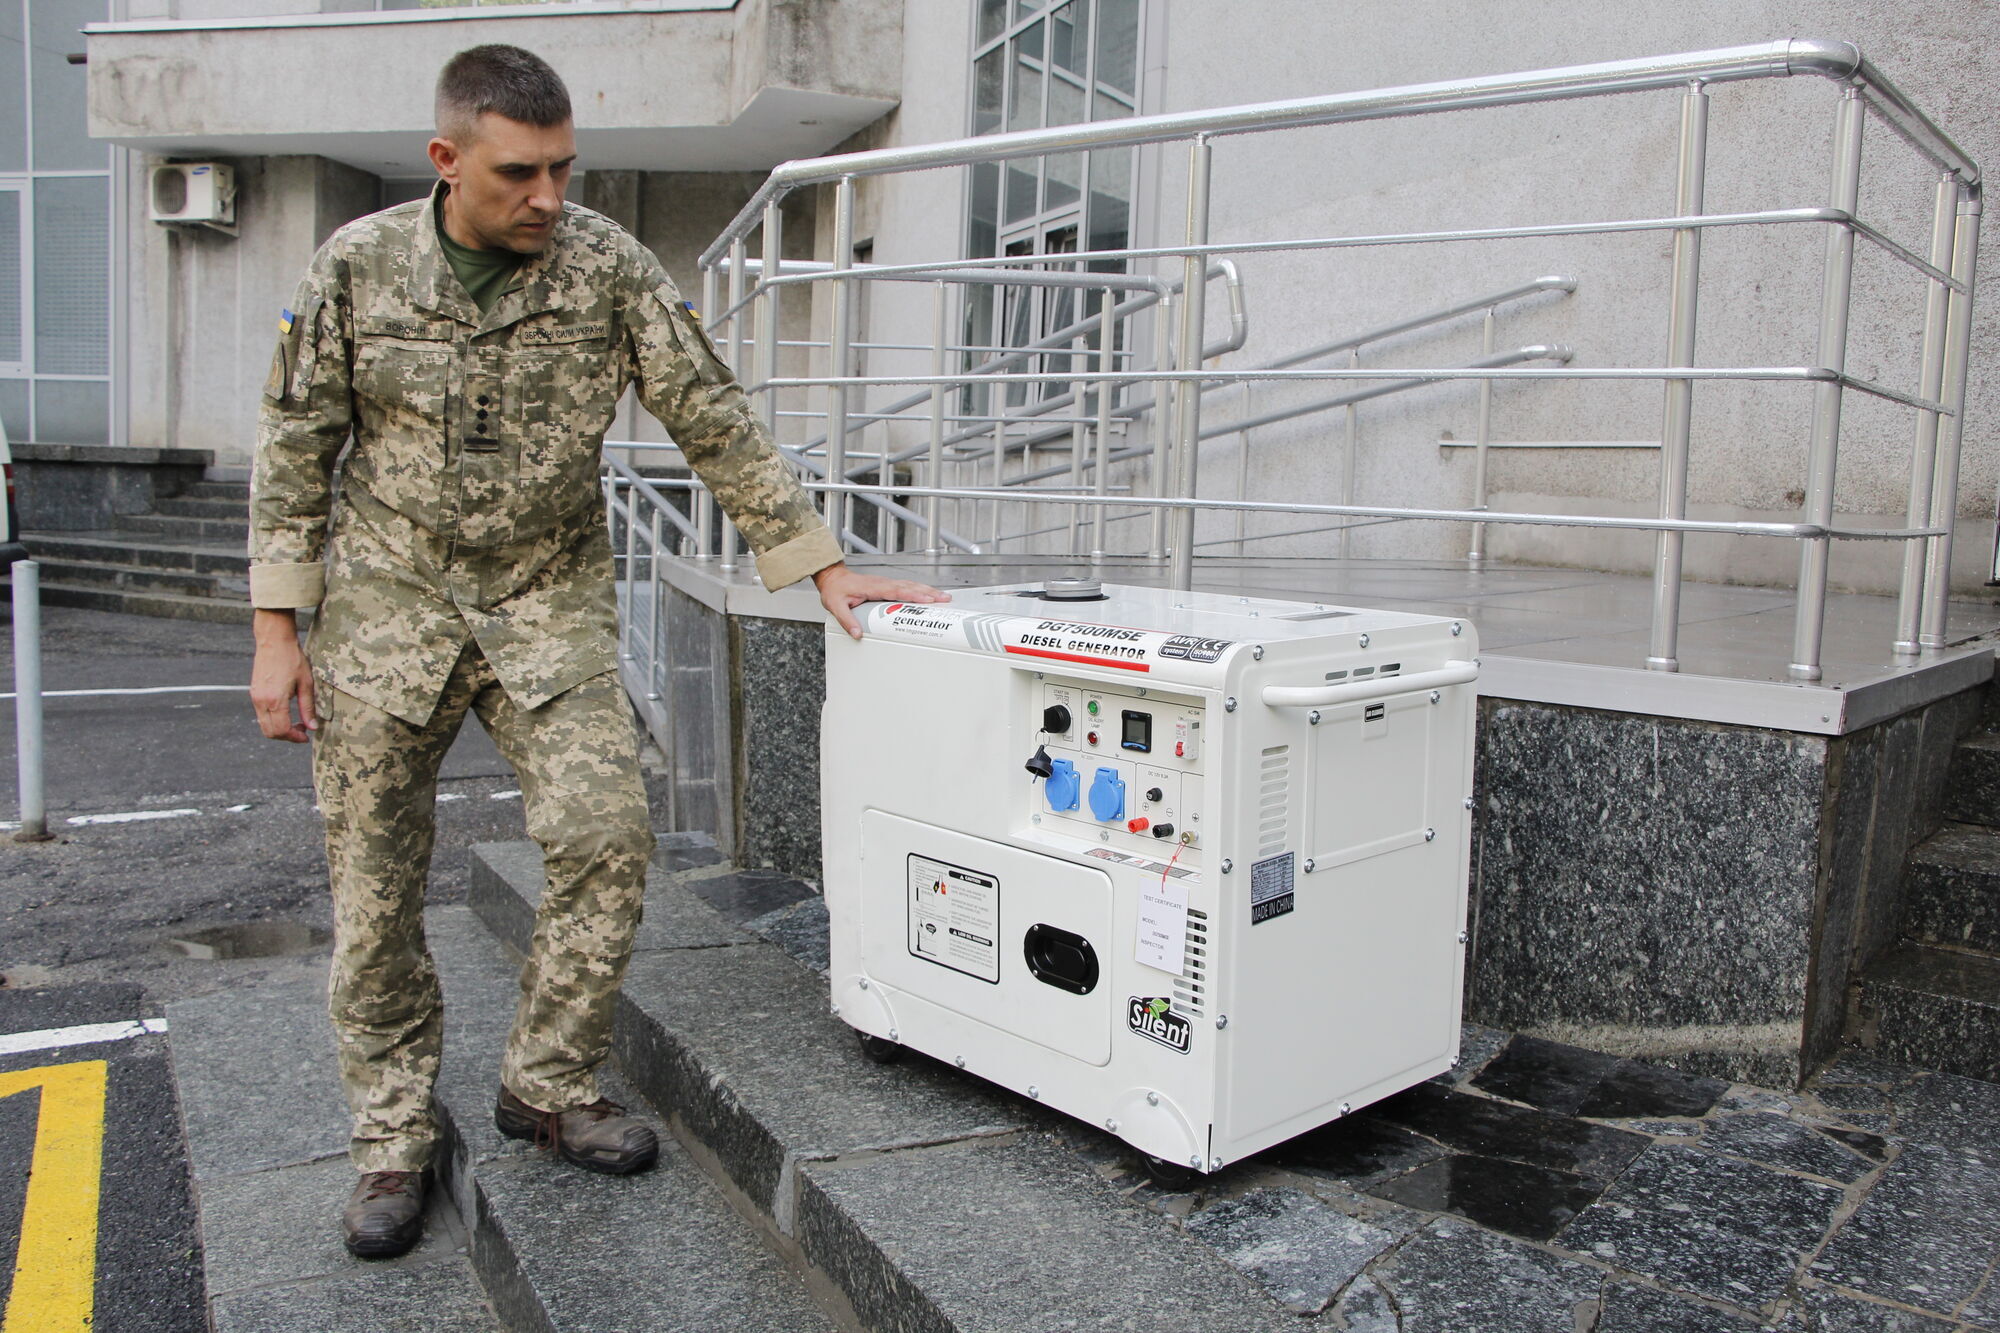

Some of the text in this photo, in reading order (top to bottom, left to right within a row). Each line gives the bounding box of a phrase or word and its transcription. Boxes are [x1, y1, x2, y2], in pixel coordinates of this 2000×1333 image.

[385, 321, 426, 335] ВОРОНІН
[556, 328, 575, 339] СИЛИ
[575, 323, 606, 337] УКРАЇНИ
[892, 615, 953, 631] generator
[1037, 620, 1147, 642] DG7500MSE
[1020, 634, 1146, 660] DIESEL GENERATOR
[1168, 636, 1199, 646] AVR
[1163, 647, 1185, 655] system
[1143, 894, 1183, 910] TEST CERTIFICATE
[1252, 895, 1294, 921] MADE IN CHINA
[1130, 1003, 1189, 1048] Silent
